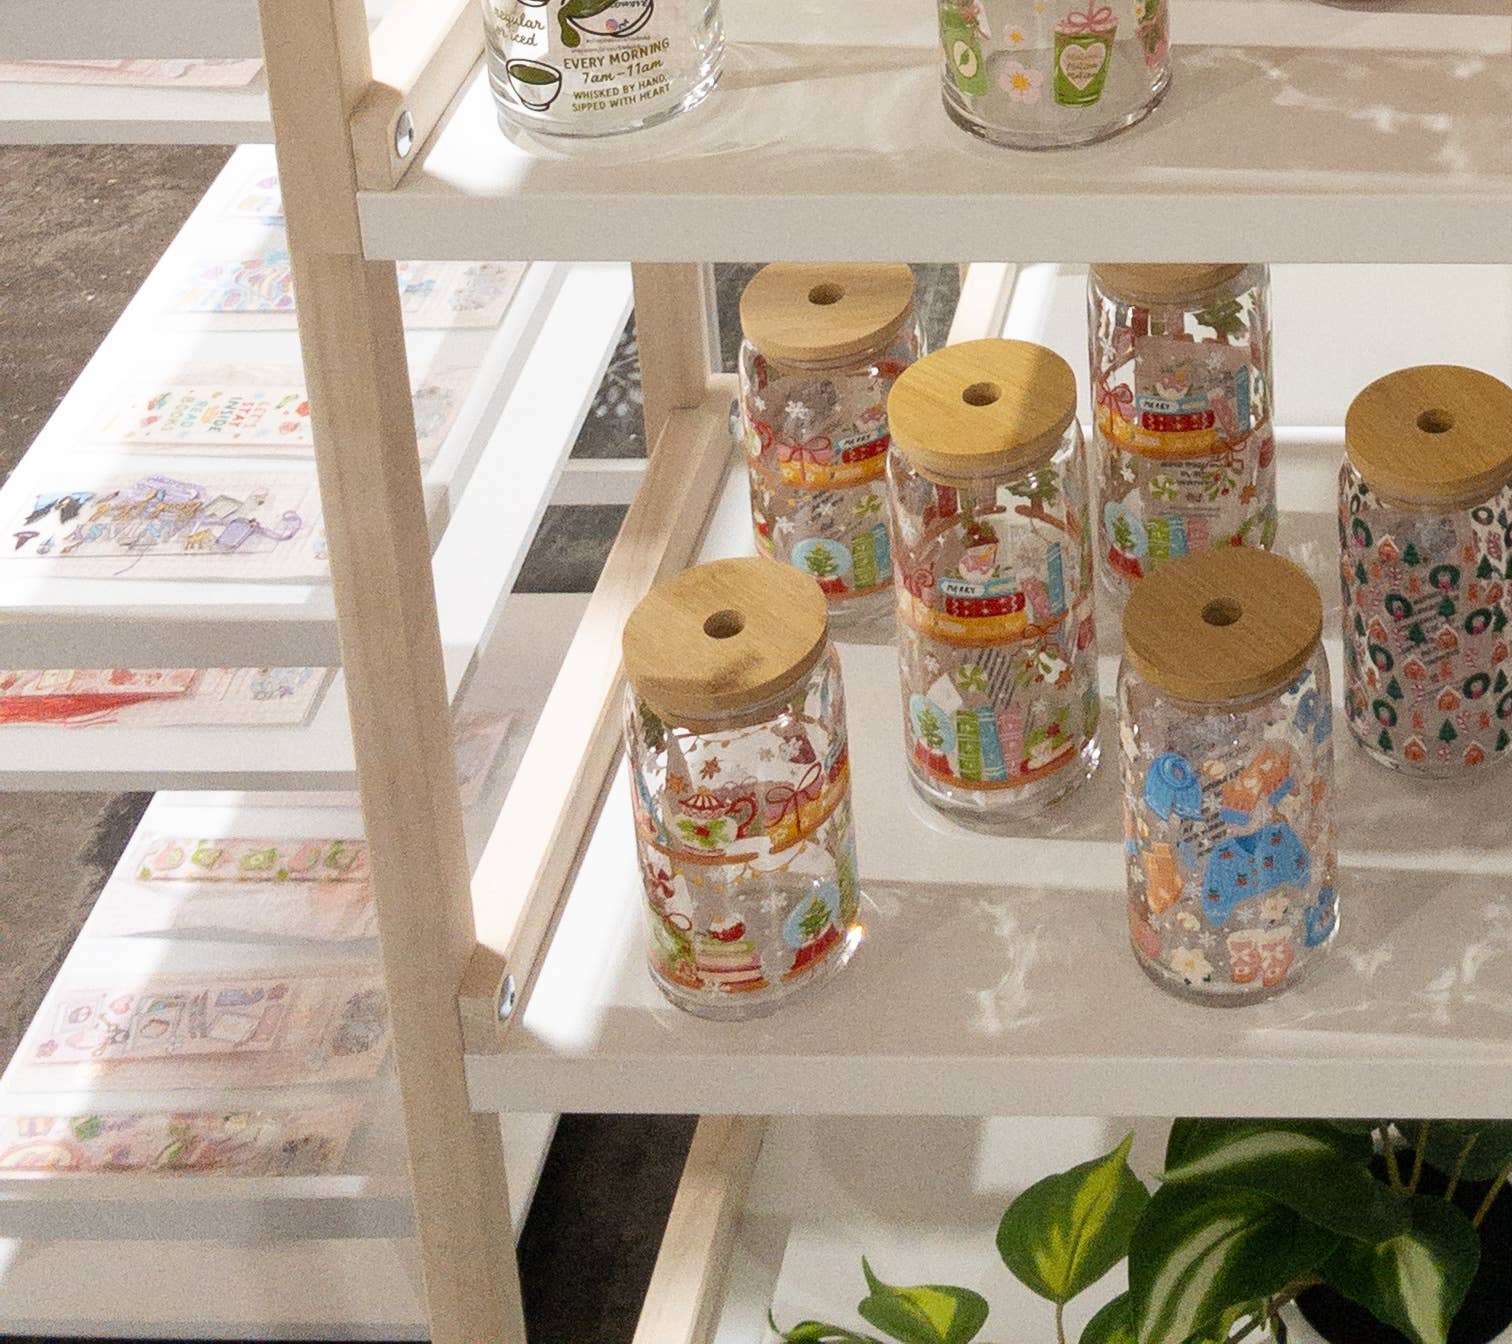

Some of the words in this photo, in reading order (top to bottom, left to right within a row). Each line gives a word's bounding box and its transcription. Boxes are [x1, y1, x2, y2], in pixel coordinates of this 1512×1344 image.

[510, 32, 539, 47] iced
[563, 56, 606, 70] EVERY
[609, 37, 671, 64] MORNING
[571, 99, 608, 113] SIPPED
[609, 95, 637, 109] WITH
[639, 83, 671, 102] HEART
[572, 86, 620, 101] WHISKED
[622, 83, 636, 94] BY
